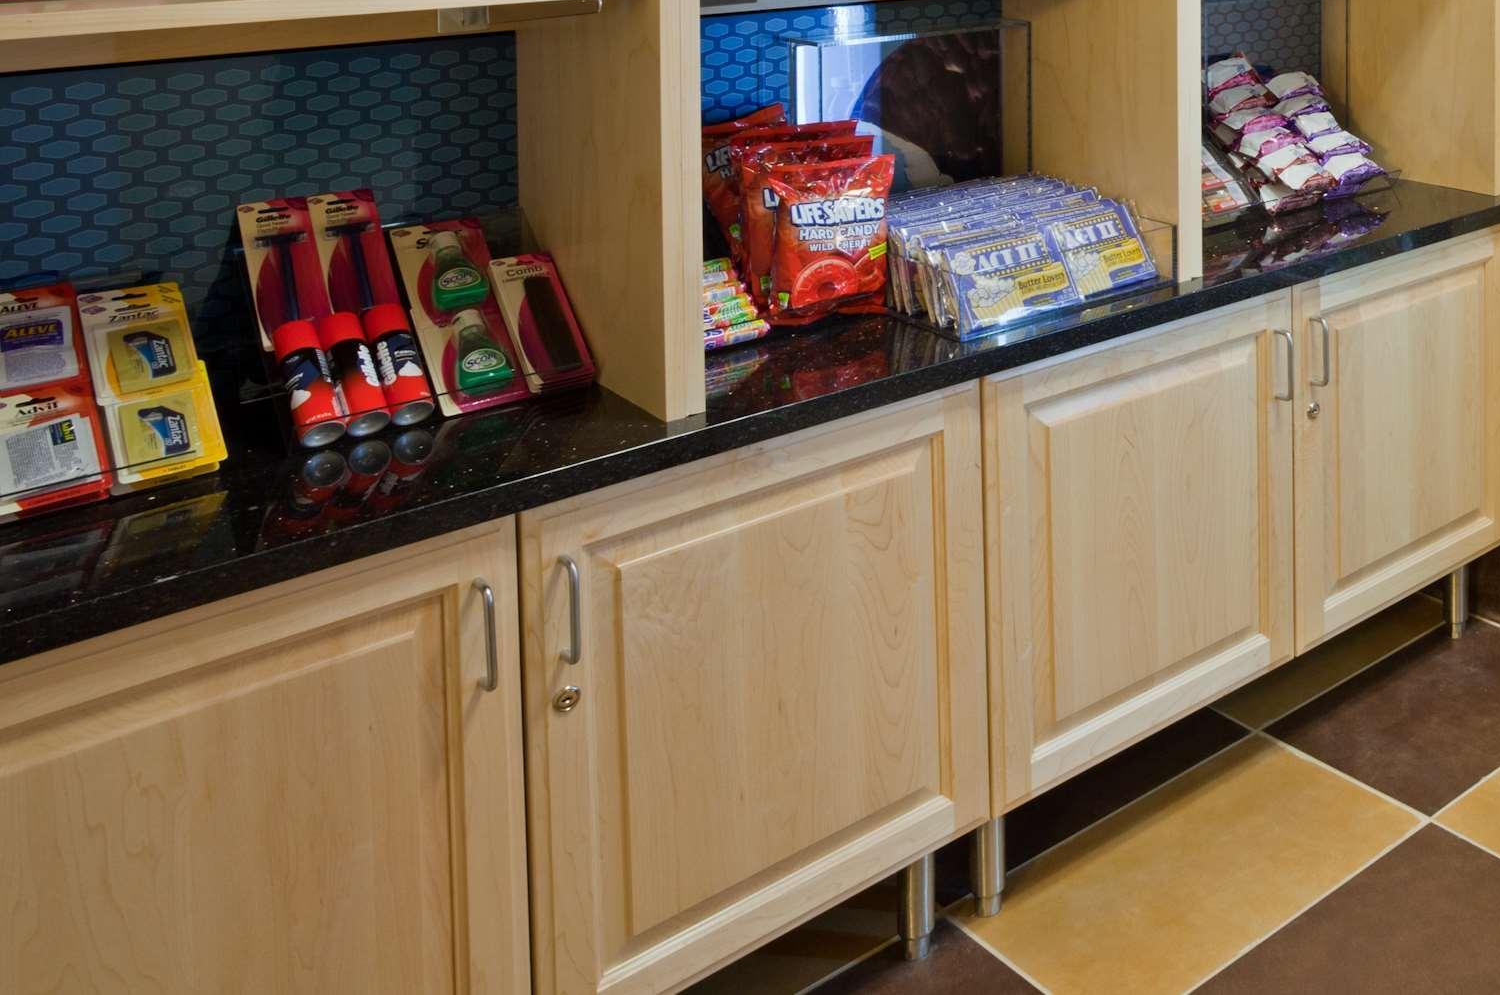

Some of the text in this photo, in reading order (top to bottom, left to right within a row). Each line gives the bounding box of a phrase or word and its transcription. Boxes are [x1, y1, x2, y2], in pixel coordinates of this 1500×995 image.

[325, 204, 360, 214] Gillette
[789, 197, 886, 227] LIFESAVERS
[256, 213, 292, 223] Gillette
[800, 224, 880, 241] HARD CANDY
[809, 242, 834, 252] WILD
[1015, 243, 1040, 262] II
[506, 266, 544, 278] Comb
[1017, 276, 1043, 289] Butter
[108, 309, 160, 325] Zantac
[5, 322, 58, 340] ALEVE
[152, 337, 169, 370] Zantac
[18, 400, 59, 416] Advil
[168, 414, 185, 446] Zantac
